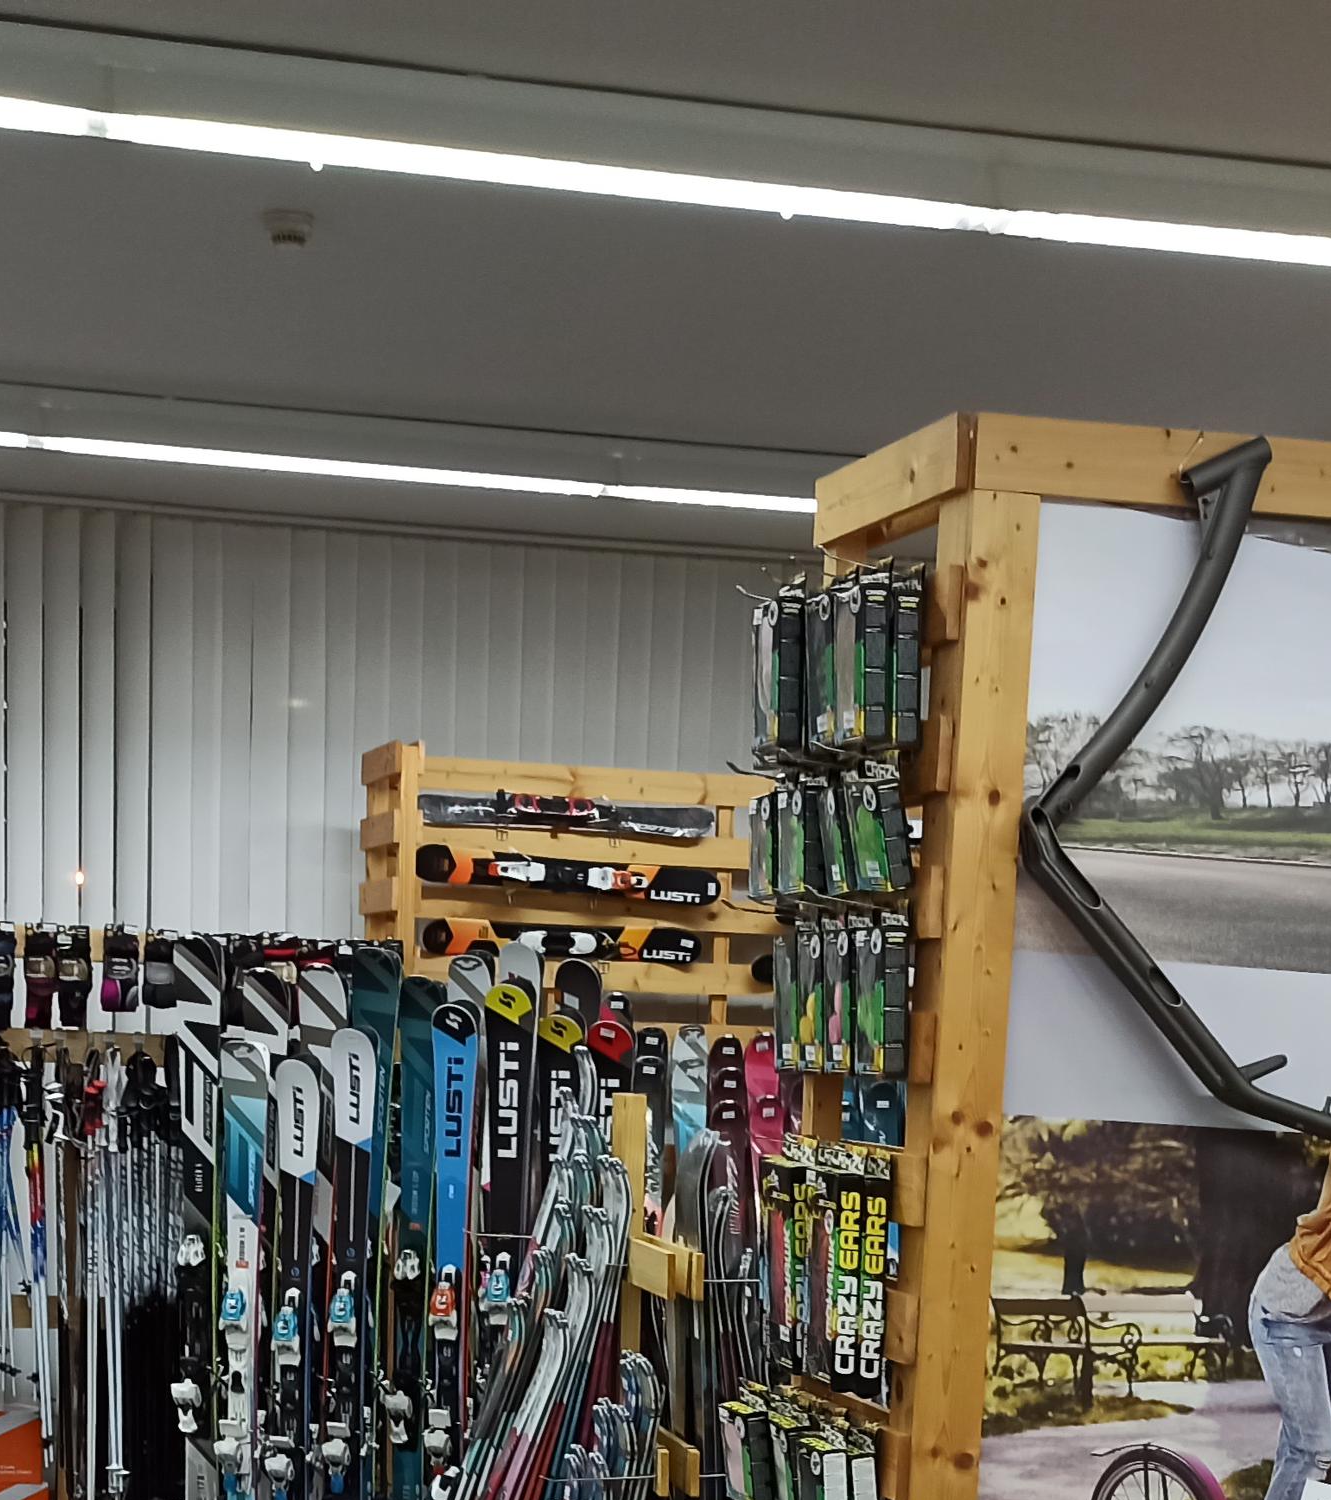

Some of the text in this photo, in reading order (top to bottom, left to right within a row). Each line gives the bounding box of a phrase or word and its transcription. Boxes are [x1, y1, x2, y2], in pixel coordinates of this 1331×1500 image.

[839, 1191, 861, 1271] EARS
[834, 1275, 858, 1375] CRAZY
[860, 1197, 887, 1379] CRAZY EARS
